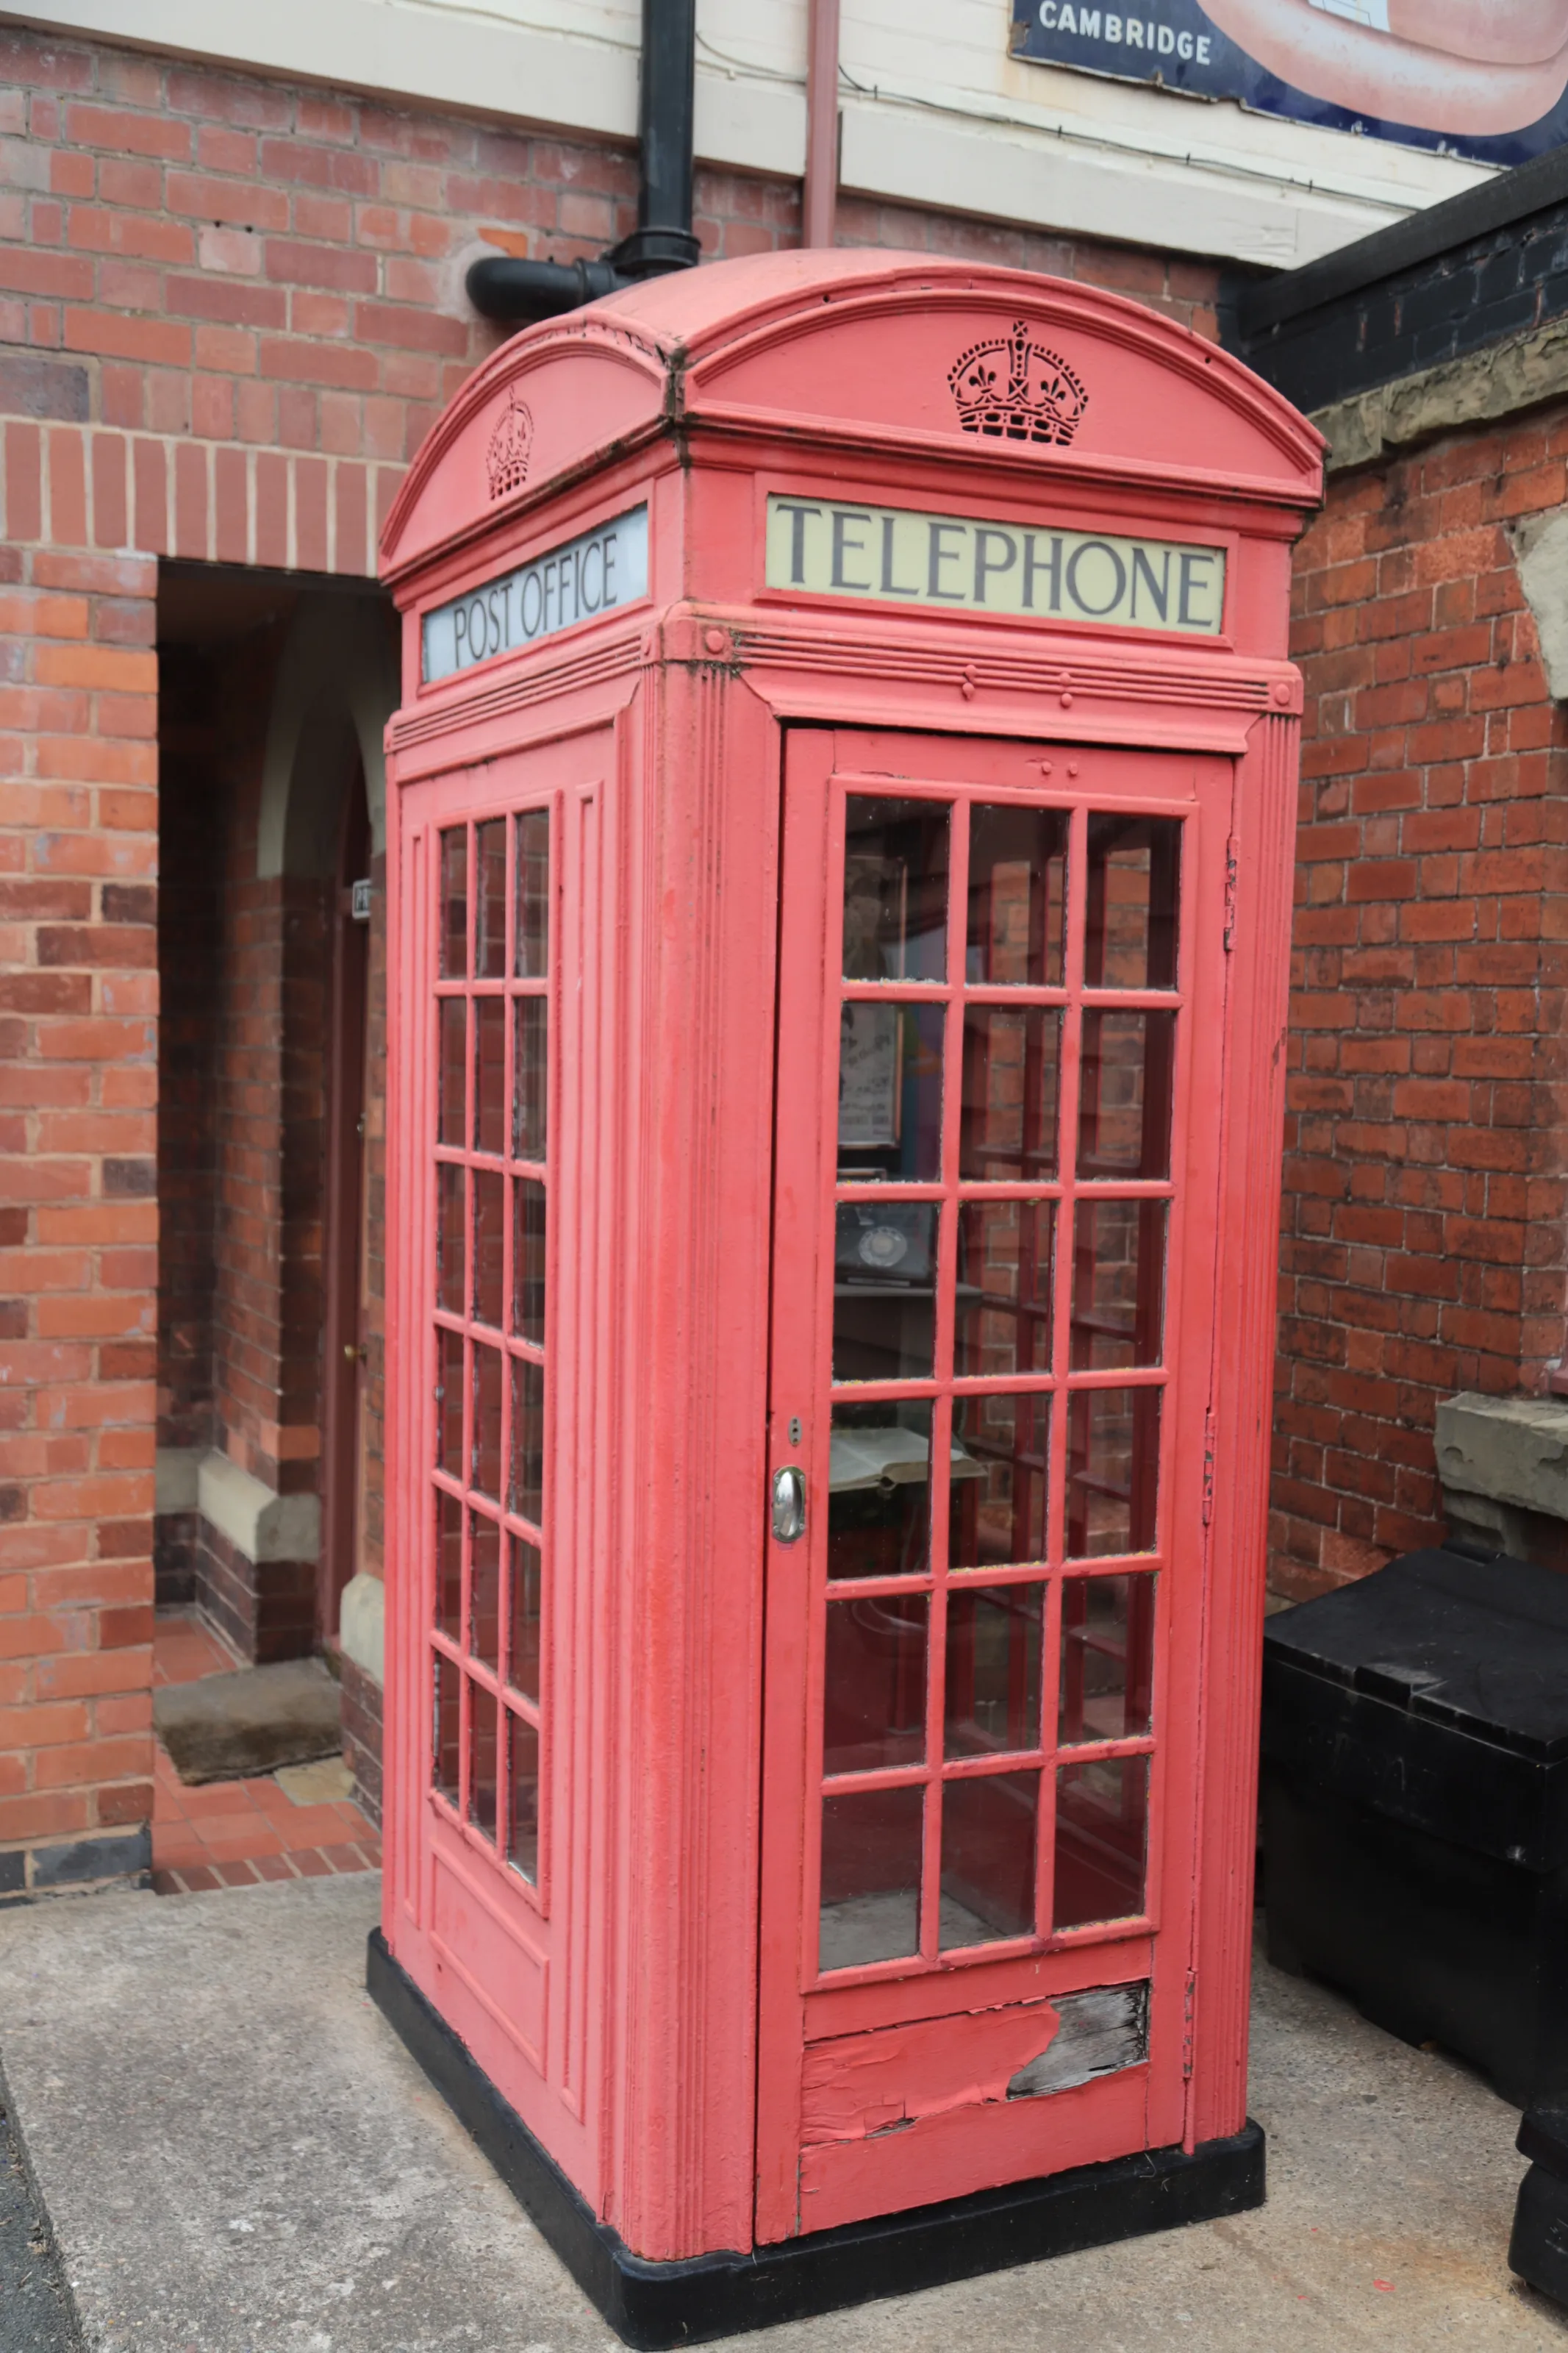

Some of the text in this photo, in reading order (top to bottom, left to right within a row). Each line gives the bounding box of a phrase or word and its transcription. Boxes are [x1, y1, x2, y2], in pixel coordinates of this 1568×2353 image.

[1039, 0, 1211, 65] CAMBRIDGE
[453, 533, 617, 668] POST OFFICE
[776, 504, 1215, 627] TELEPHONE
